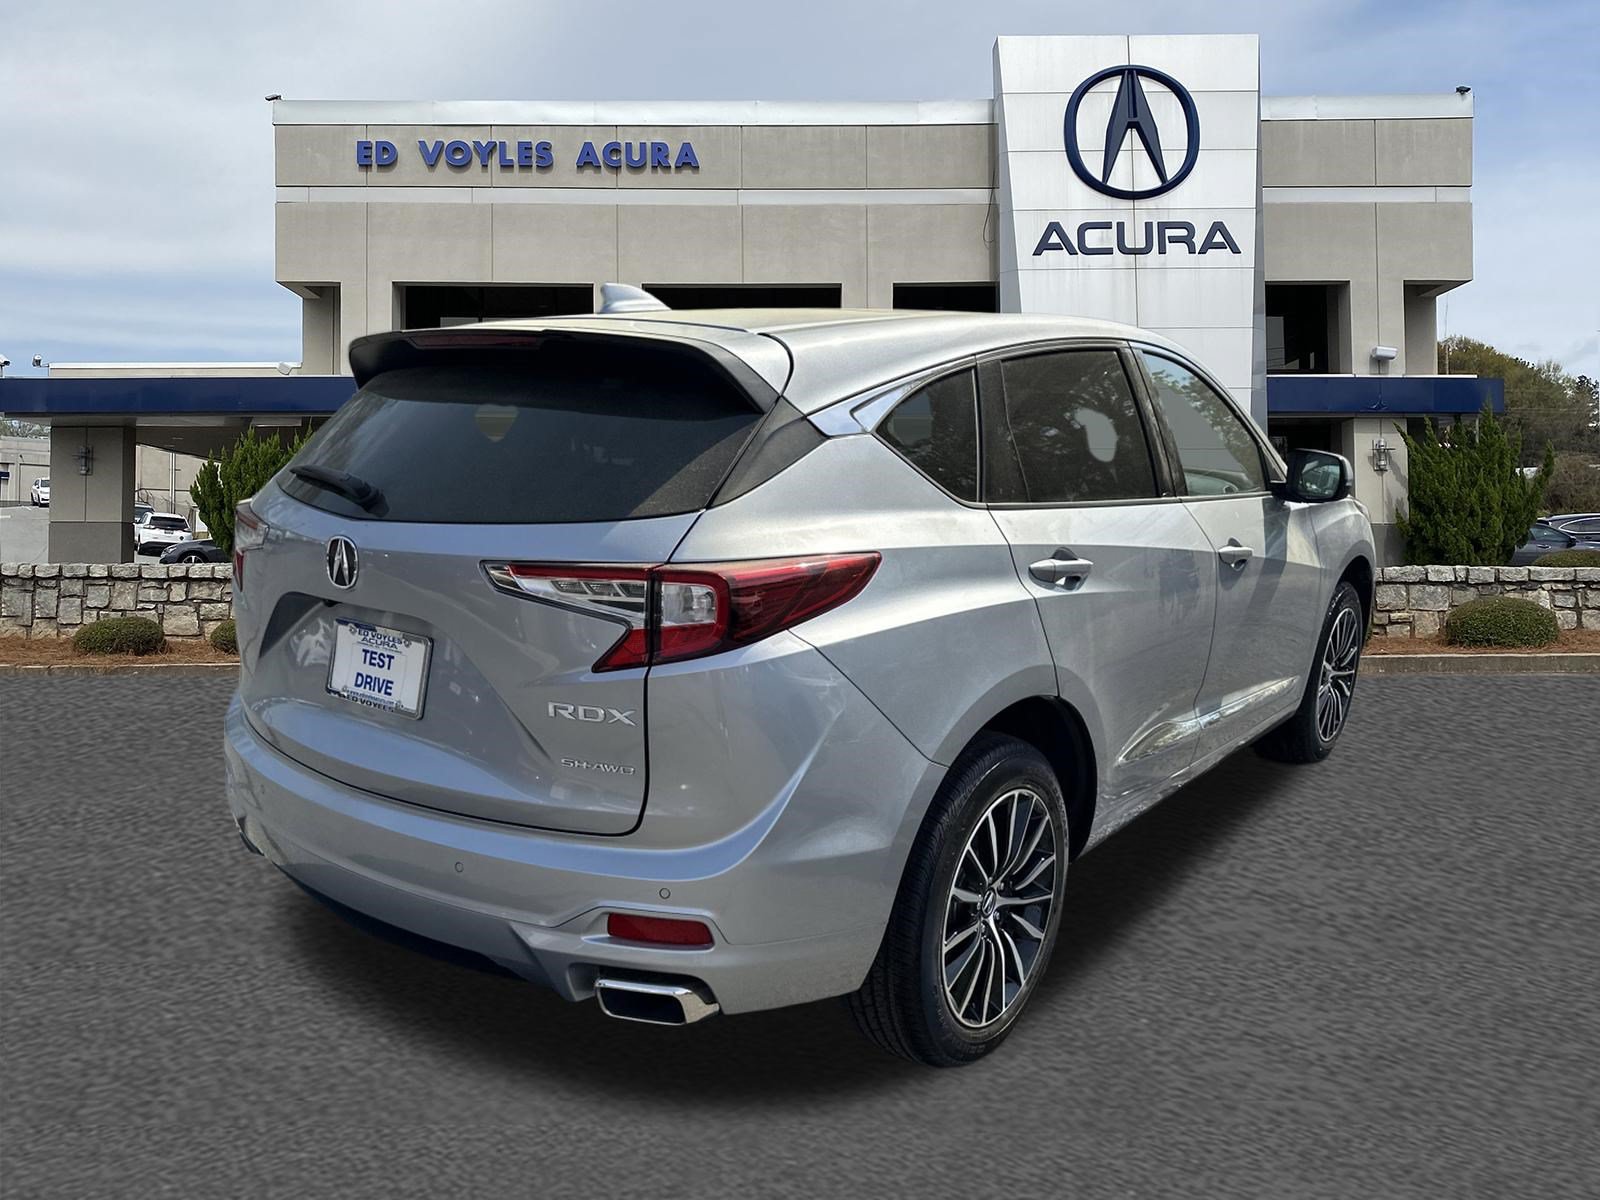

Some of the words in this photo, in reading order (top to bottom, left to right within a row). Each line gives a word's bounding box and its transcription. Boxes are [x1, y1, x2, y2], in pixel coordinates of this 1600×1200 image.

[356, 140, 398, 167] ED
[418, 140, 554, 168] VOYLES
[576, 142, 700, 168] ACURA
[1032, 221, 1241, 256] ACURA
[358, 629, 369, 637] ED
[371, 630, 403, 645] VOYLES
[361, 637, 398, 650] ACURA
[362, 649, 395, 671] TEST
[354, 672, 394, 696] DRIVE
[548, 702, 637, 727] RDX
[561, 758, 635, 776] SH-AWD
